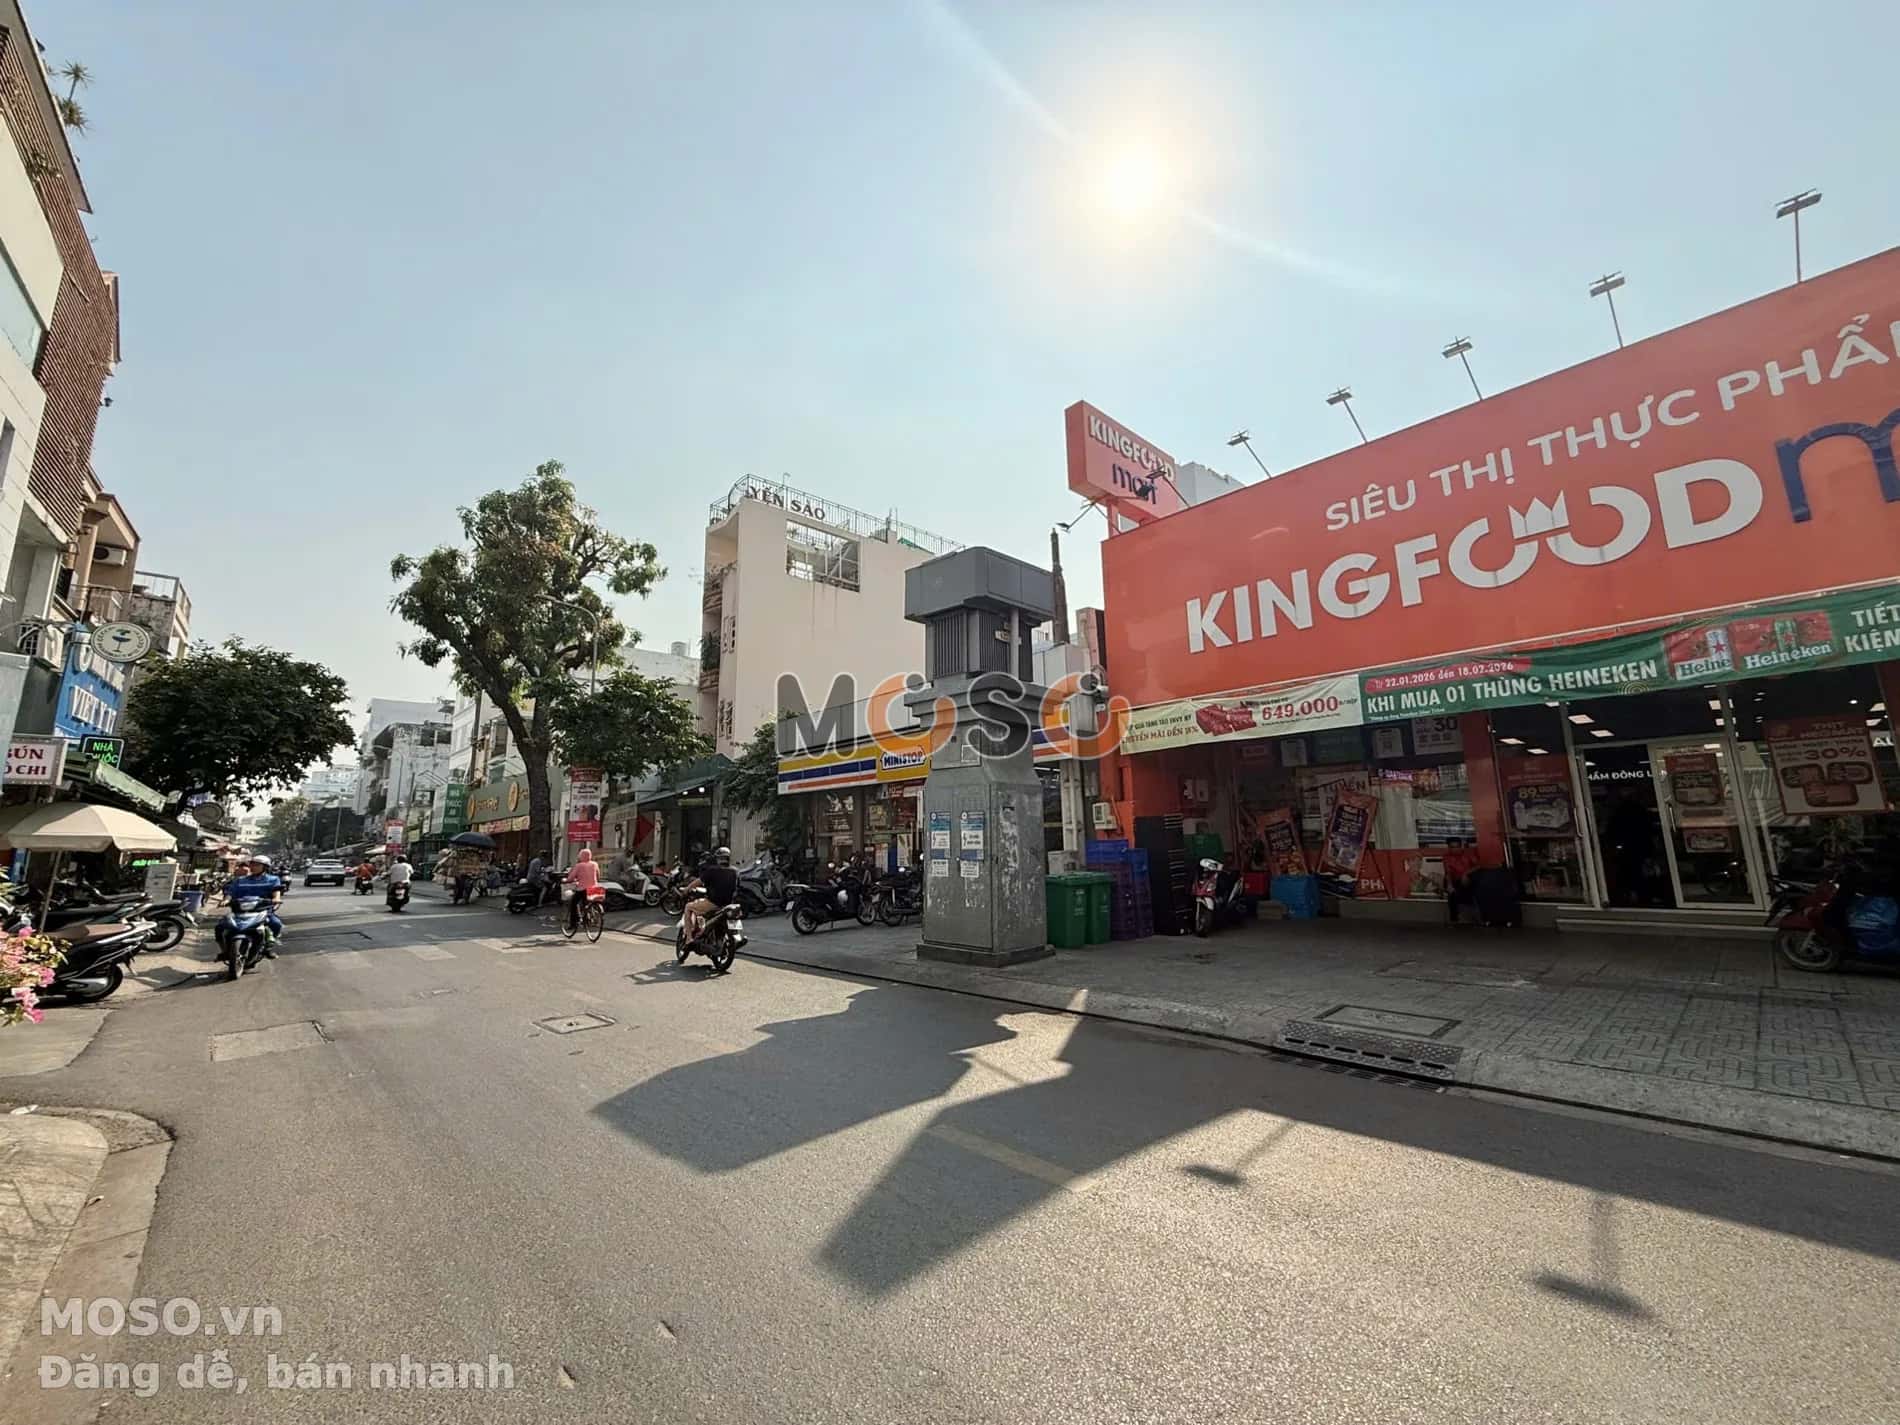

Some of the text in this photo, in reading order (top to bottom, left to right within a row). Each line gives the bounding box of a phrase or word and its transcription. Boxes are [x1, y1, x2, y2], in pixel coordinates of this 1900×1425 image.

[1089, 415, 1175, 482] KINGFOOD
[1326, 478, 1417, 531] SIÊU
[1430, 446, 1514, 485] THỊ
[1527, 390, 1700, 451] THỰC
[1186, 458, 1763, 653] KINGFOOD
[1850, 601, 1900, 627] TIẾT
[1679, 657, 1732, 677] Heine
[1744, 642, 1833, 669] Heineken
[1367, 659, 1658, 714] KHI MUA 01 THÙNG HEINEKEN
[1385, 673, 1435, 688] 22.01.2026
[1457, 660, 1514, 678] 18.02.2026
[1262, 696, 1338, 720] 649.000
[884, 752, 923, 767] MINISTOP
[1805, 747, 1866, 761] 30%
[16, 765, 47, 775] CHI
[1611, 769, 1645, 780] ĐÔNG
